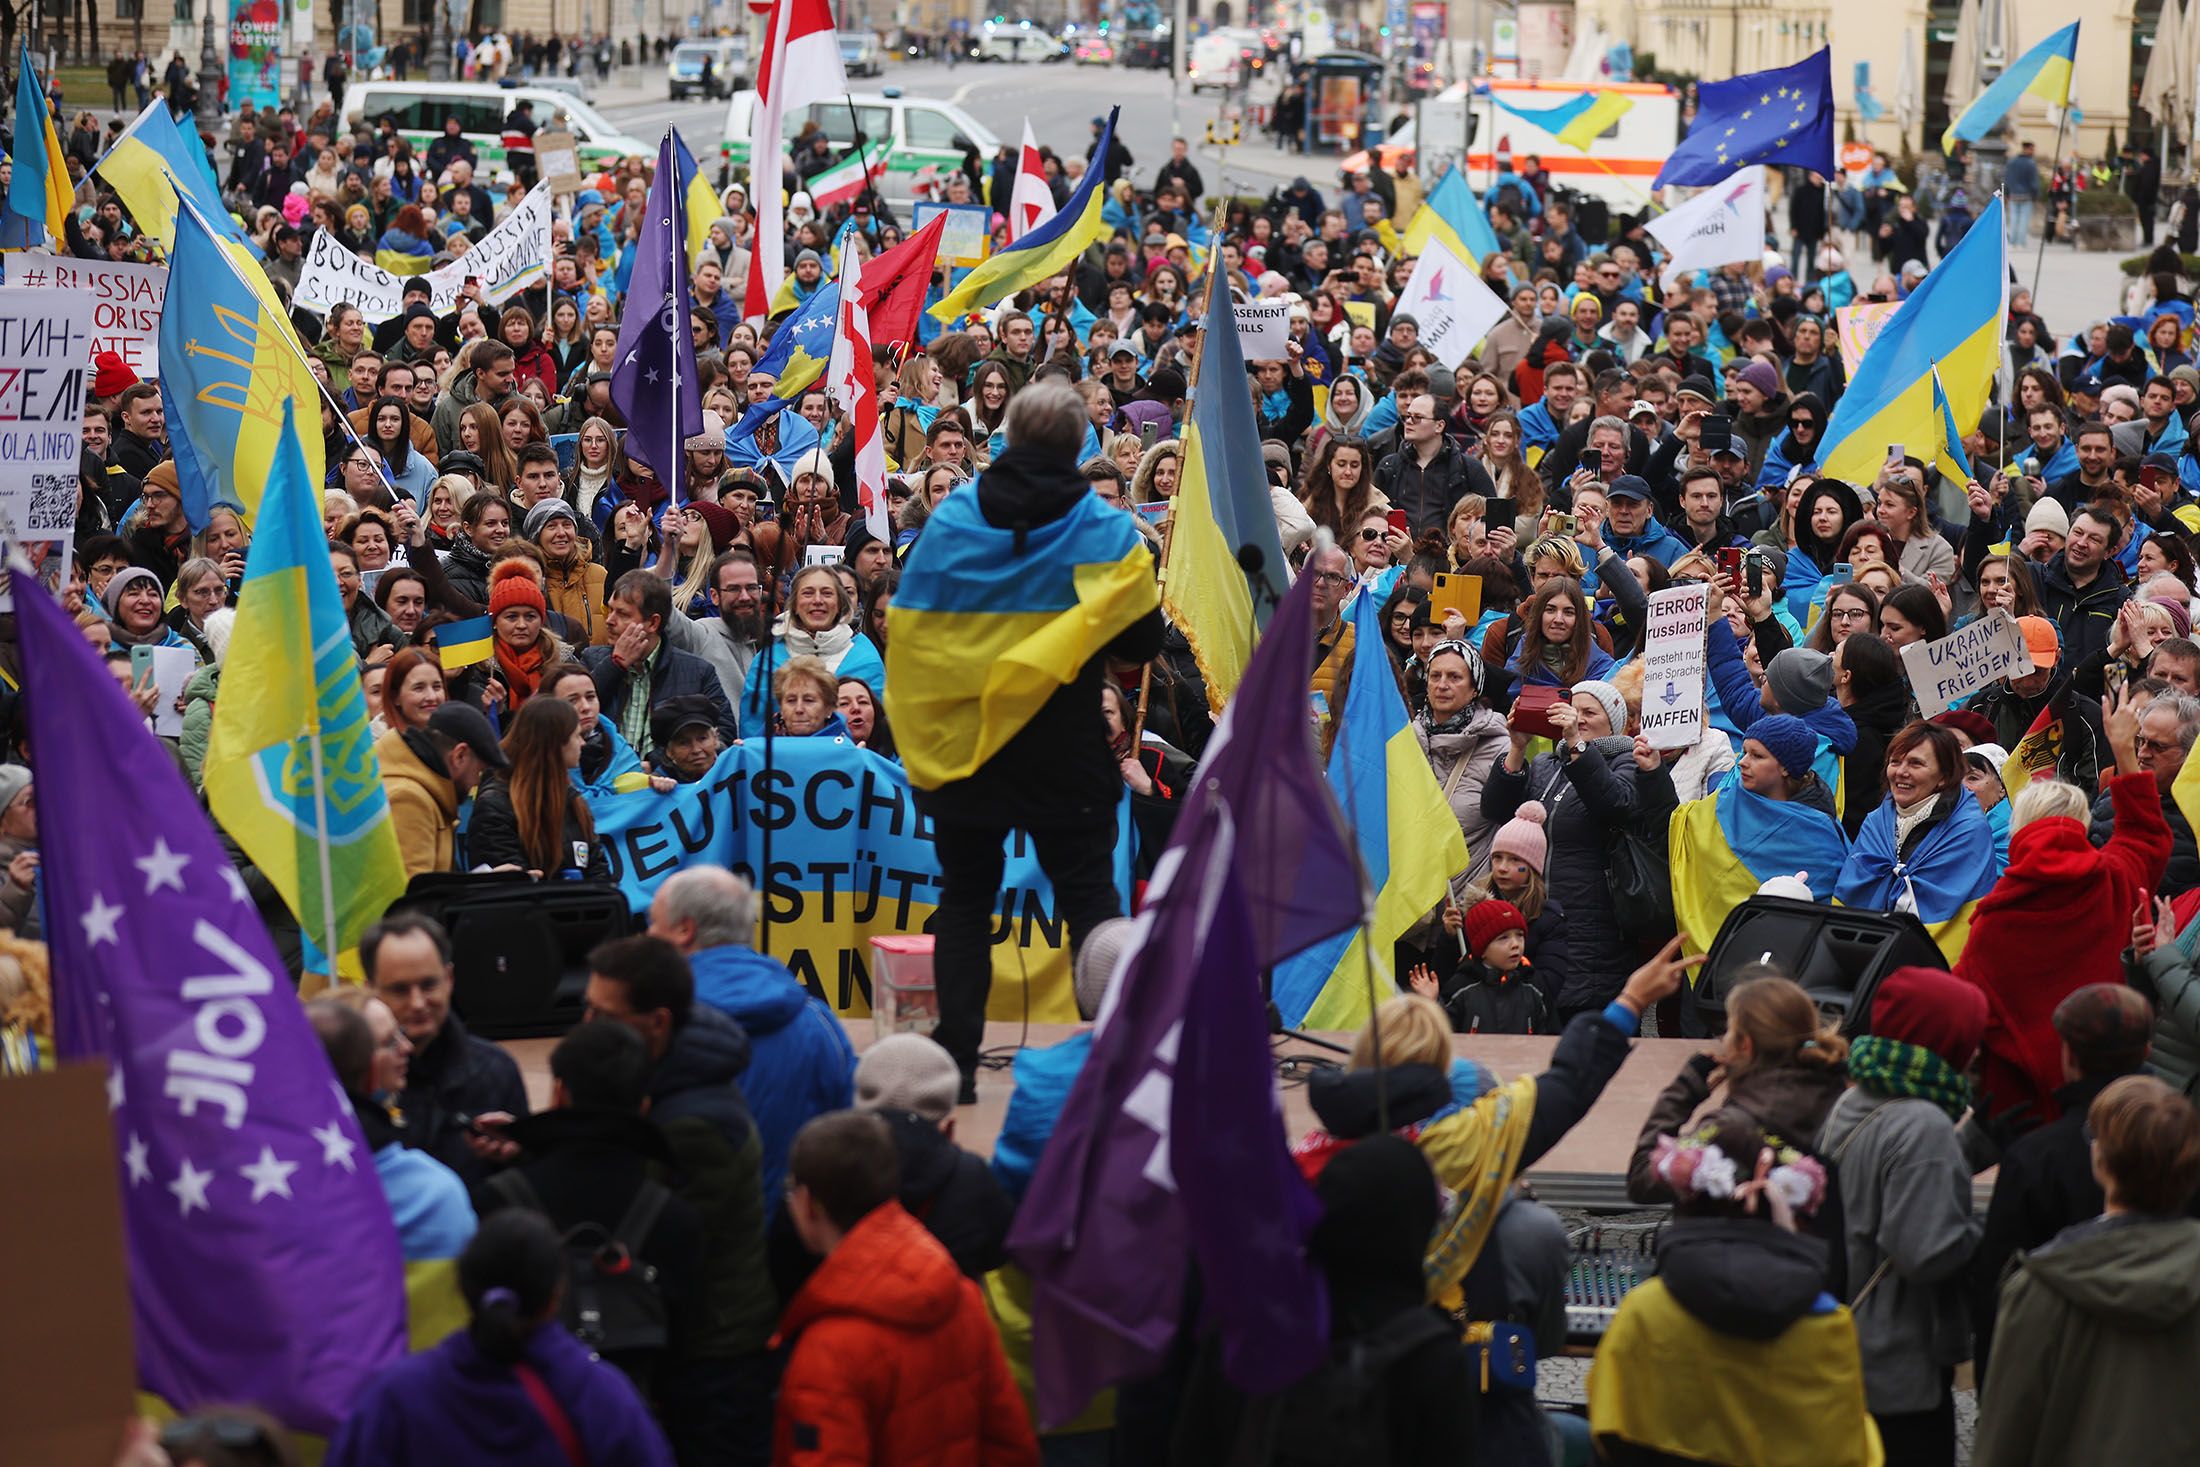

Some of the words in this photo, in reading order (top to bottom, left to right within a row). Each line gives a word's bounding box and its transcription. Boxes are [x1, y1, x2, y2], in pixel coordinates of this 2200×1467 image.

[308, 276, 399, 312] SUPPOR
[1233, 307, 1287, 318] ASEMENT
[1649, 595, 1705, 618] TERROR
[1647, 617, 1704, 640] russland
[1646, 651, 1684, 666] versteht
[1685, 649, 1702, 660] nur
[1644, 669, 1663, 682] eine
[1665, 664, 1702, 680] Sprache
[1641, 708, 1699, 730] WAFFEN
